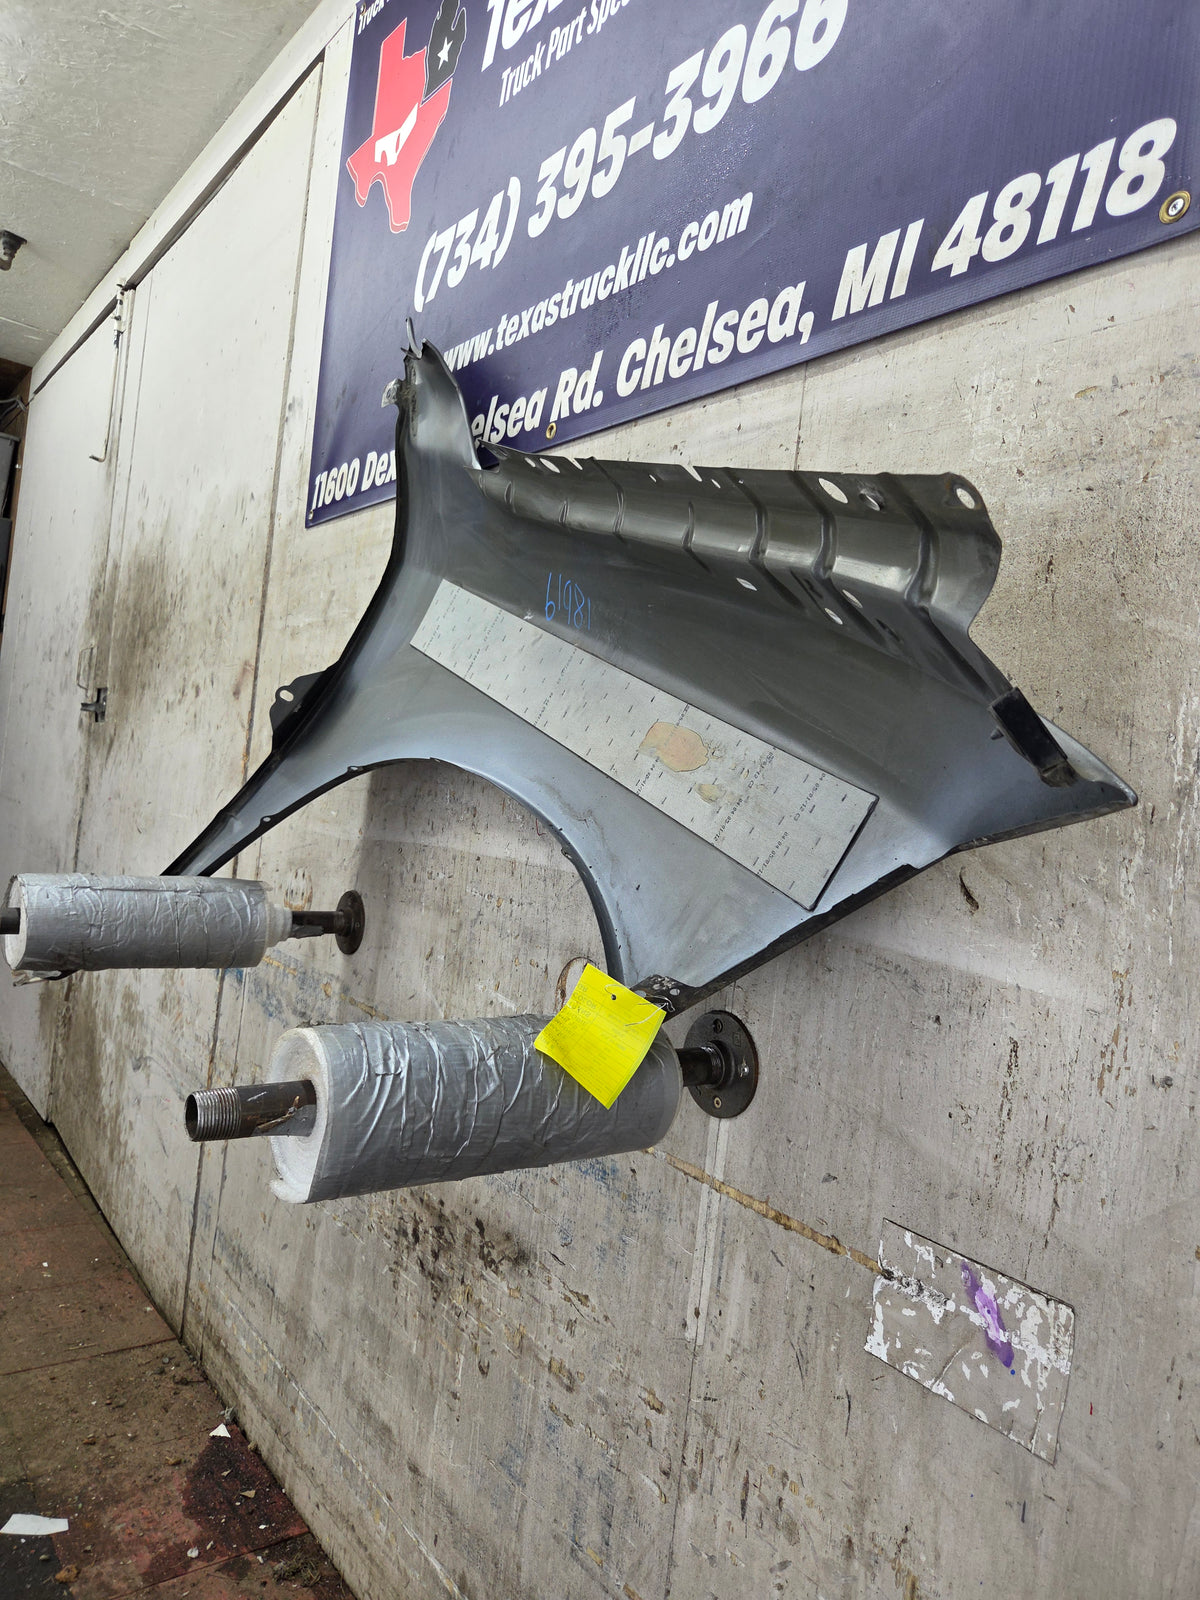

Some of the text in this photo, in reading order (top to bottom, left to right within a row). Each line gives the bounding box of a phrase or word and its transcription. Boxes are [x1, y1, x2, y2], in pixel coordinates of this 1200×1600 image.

[499, 41, 546, 108] Truck
[545, 7, 587, 70] Part
[414, 0, 848, 312] (734) 395-3966
[312, 457, 360, 510] 11600
[550, 351, 604, 423] Rd.
[617, 280, 814, 397] Chelsea,
[831, 219, 925, 321] MI
[931, 118, 1177, 277] 48118
[443, 191, 753, 373] www.texastruckllc.com
[545, 572, 591, 631] 61981
